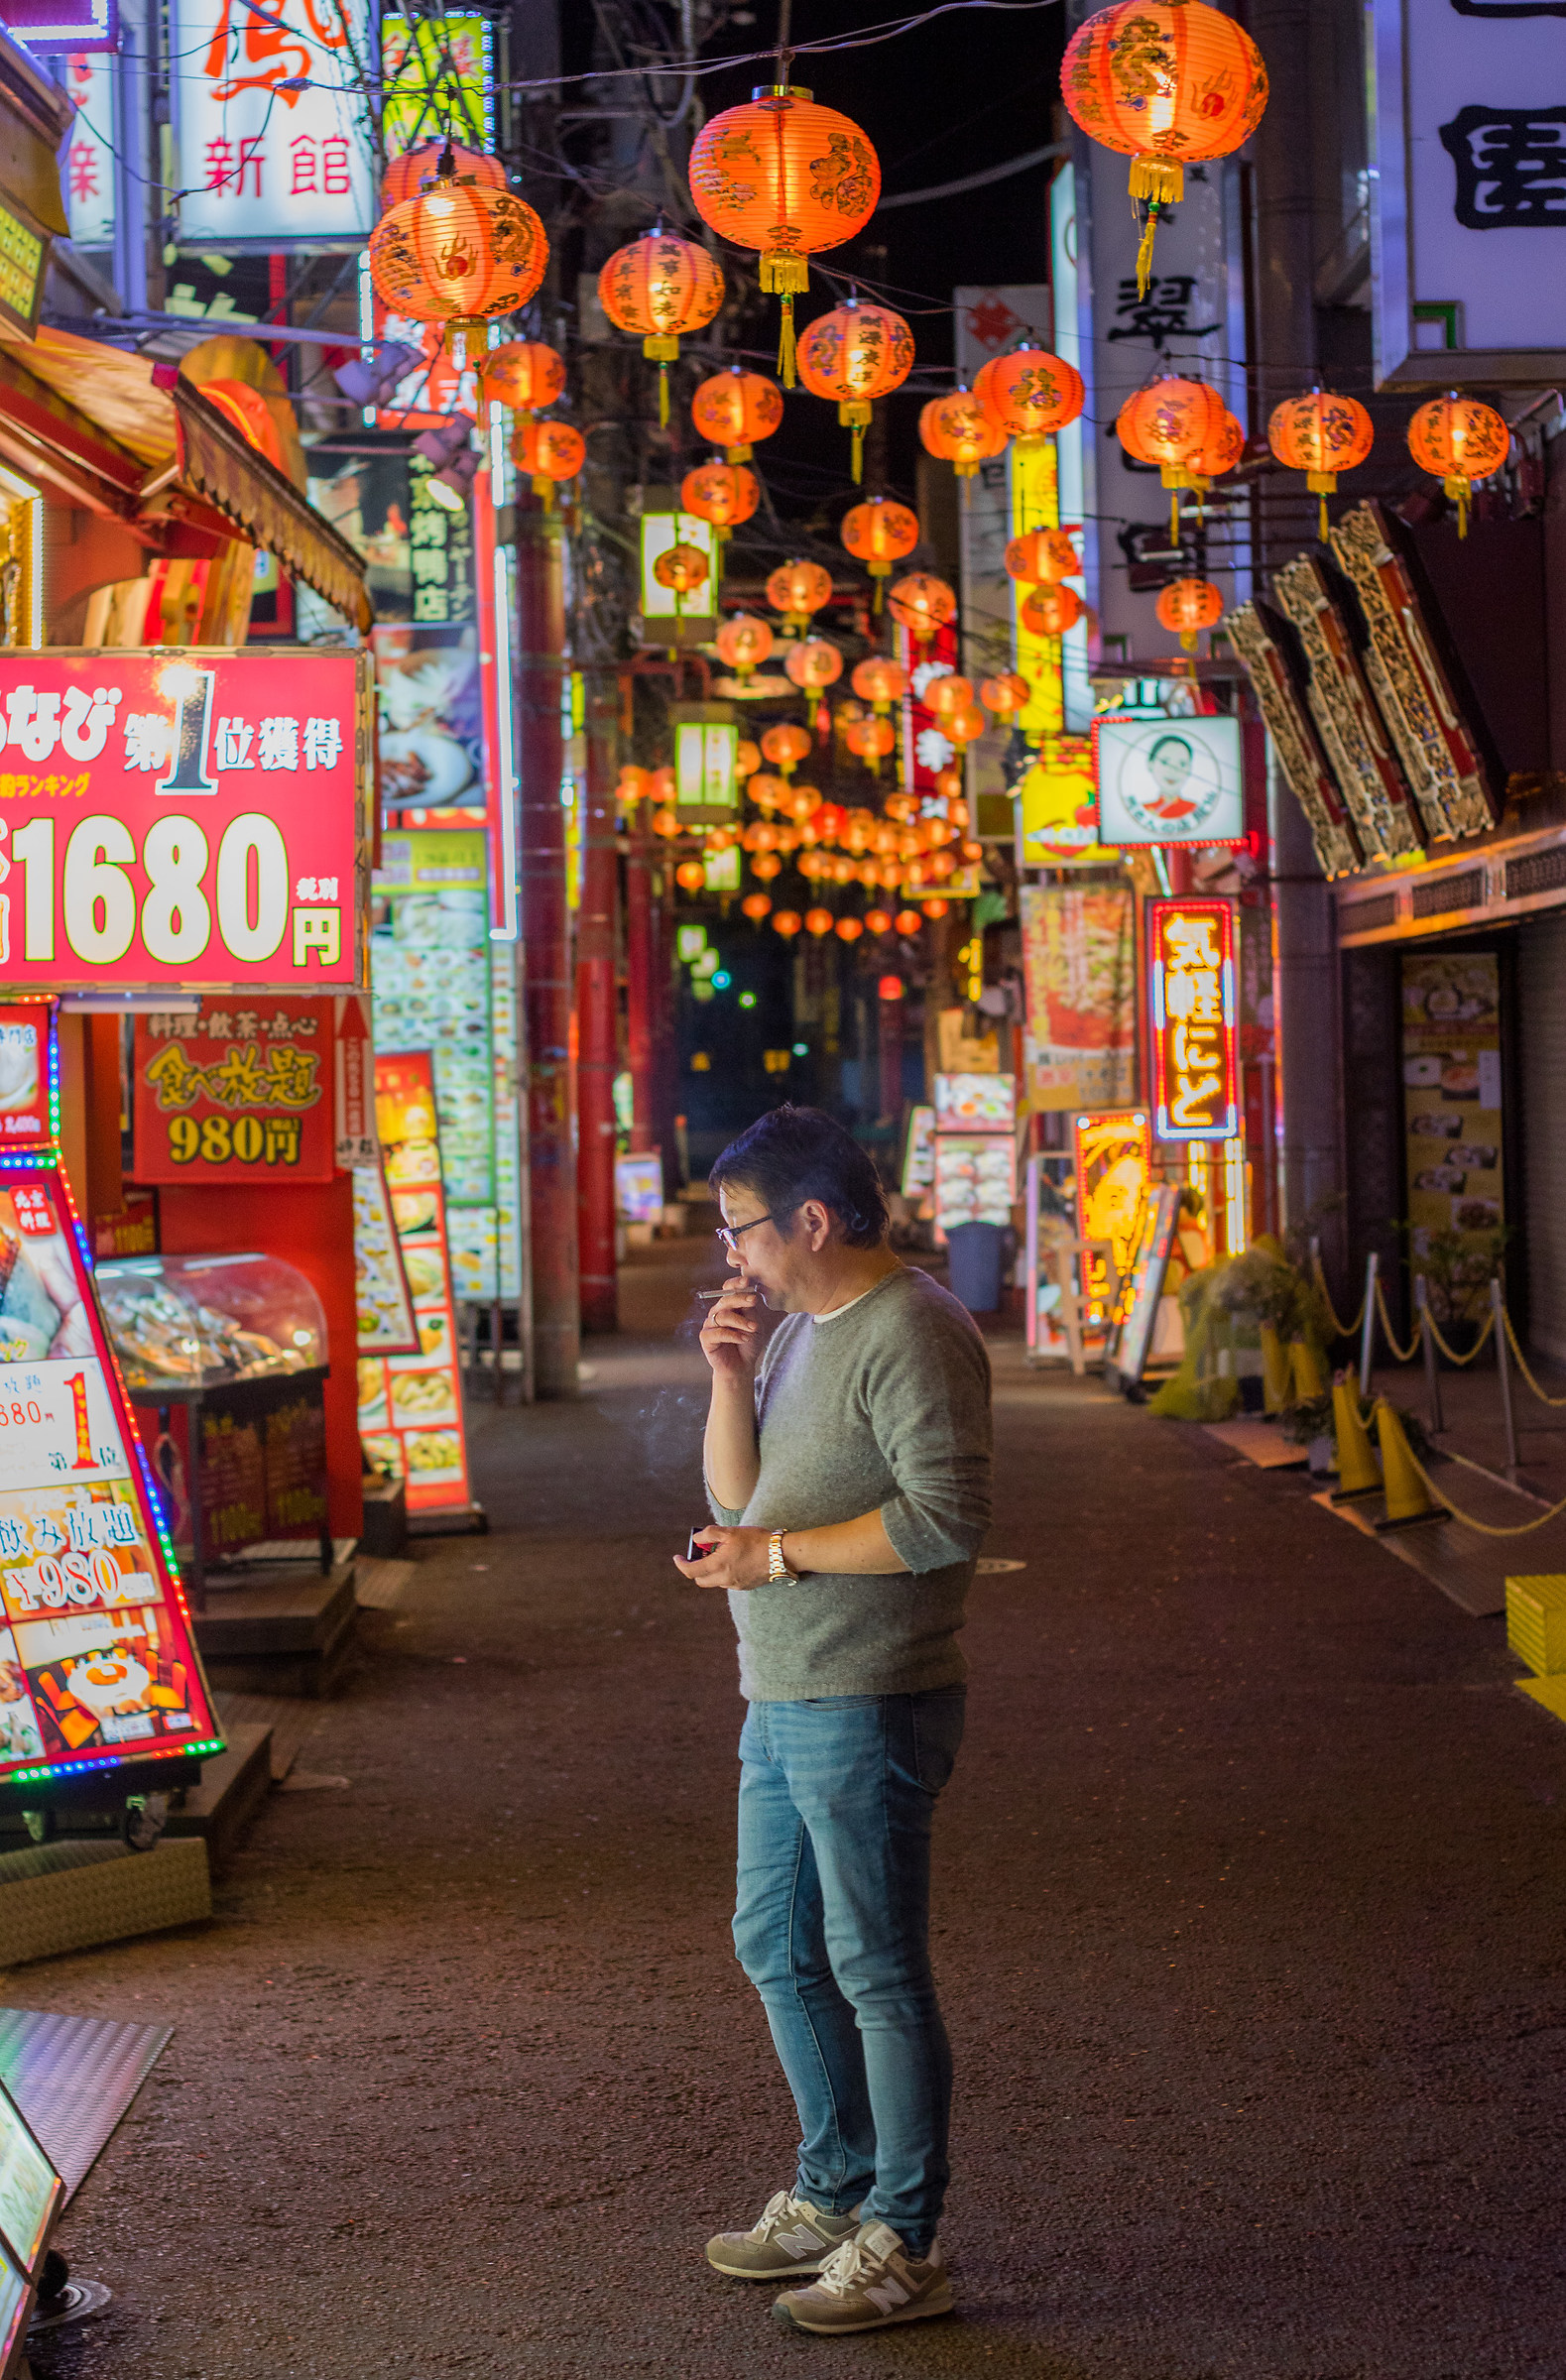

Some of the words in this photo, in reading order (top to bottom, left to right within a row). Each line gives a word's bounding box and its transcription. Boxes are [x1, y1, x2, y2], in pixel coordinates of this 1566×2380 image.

[203, 133, 351, 198] 新館
[0, 685, 123, 762] なび
[146, 1040, 323, 1111] 食べ放題
